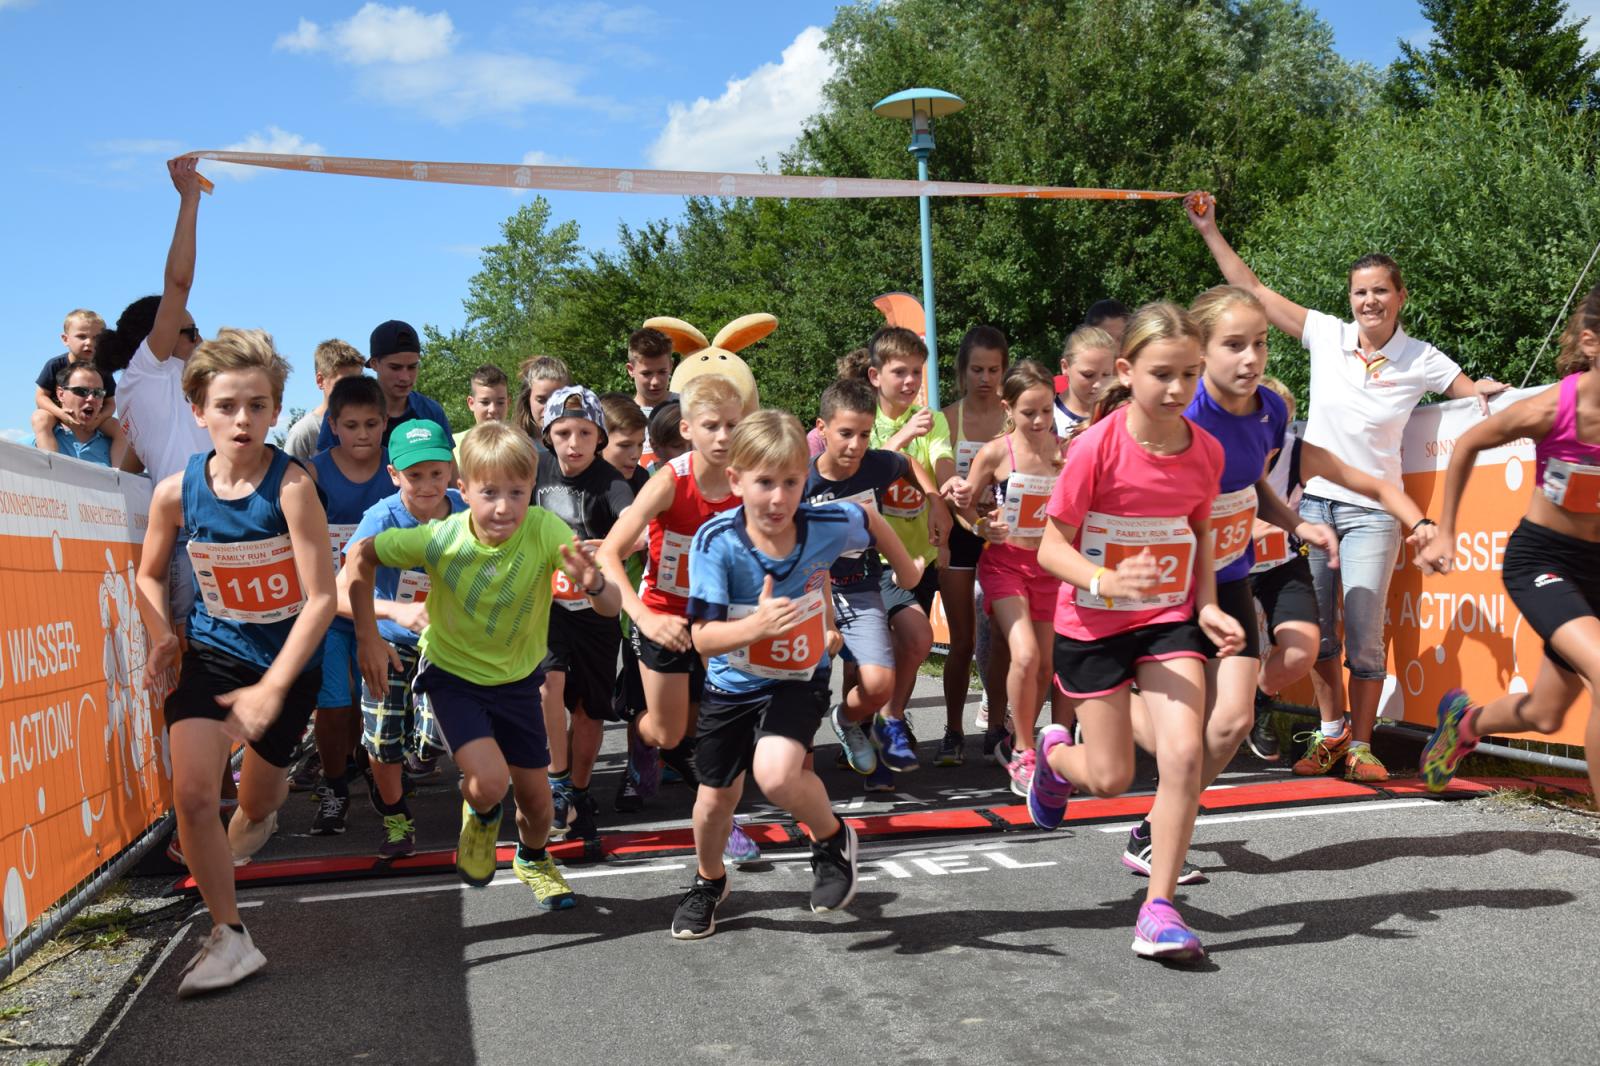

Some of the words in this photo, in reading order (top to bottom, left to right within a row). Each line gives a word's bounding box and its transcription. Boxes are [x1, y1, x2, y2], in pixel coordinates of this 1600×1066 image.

[1115, 529, 1147, 538] FAMILY
[1149, 529, 1169, 538] RUN
[216, 553, 245, 562] FAMILY
[247, 551, 267, 561] RUN
[227, 573, 289, 603] 119
[1400, 591, 1505, 634] ACTION!
[8, 620, 81, 685] WASSER-
[770, 634, 810, 663] 58
[10, 700, 74, 780] ACTION!
